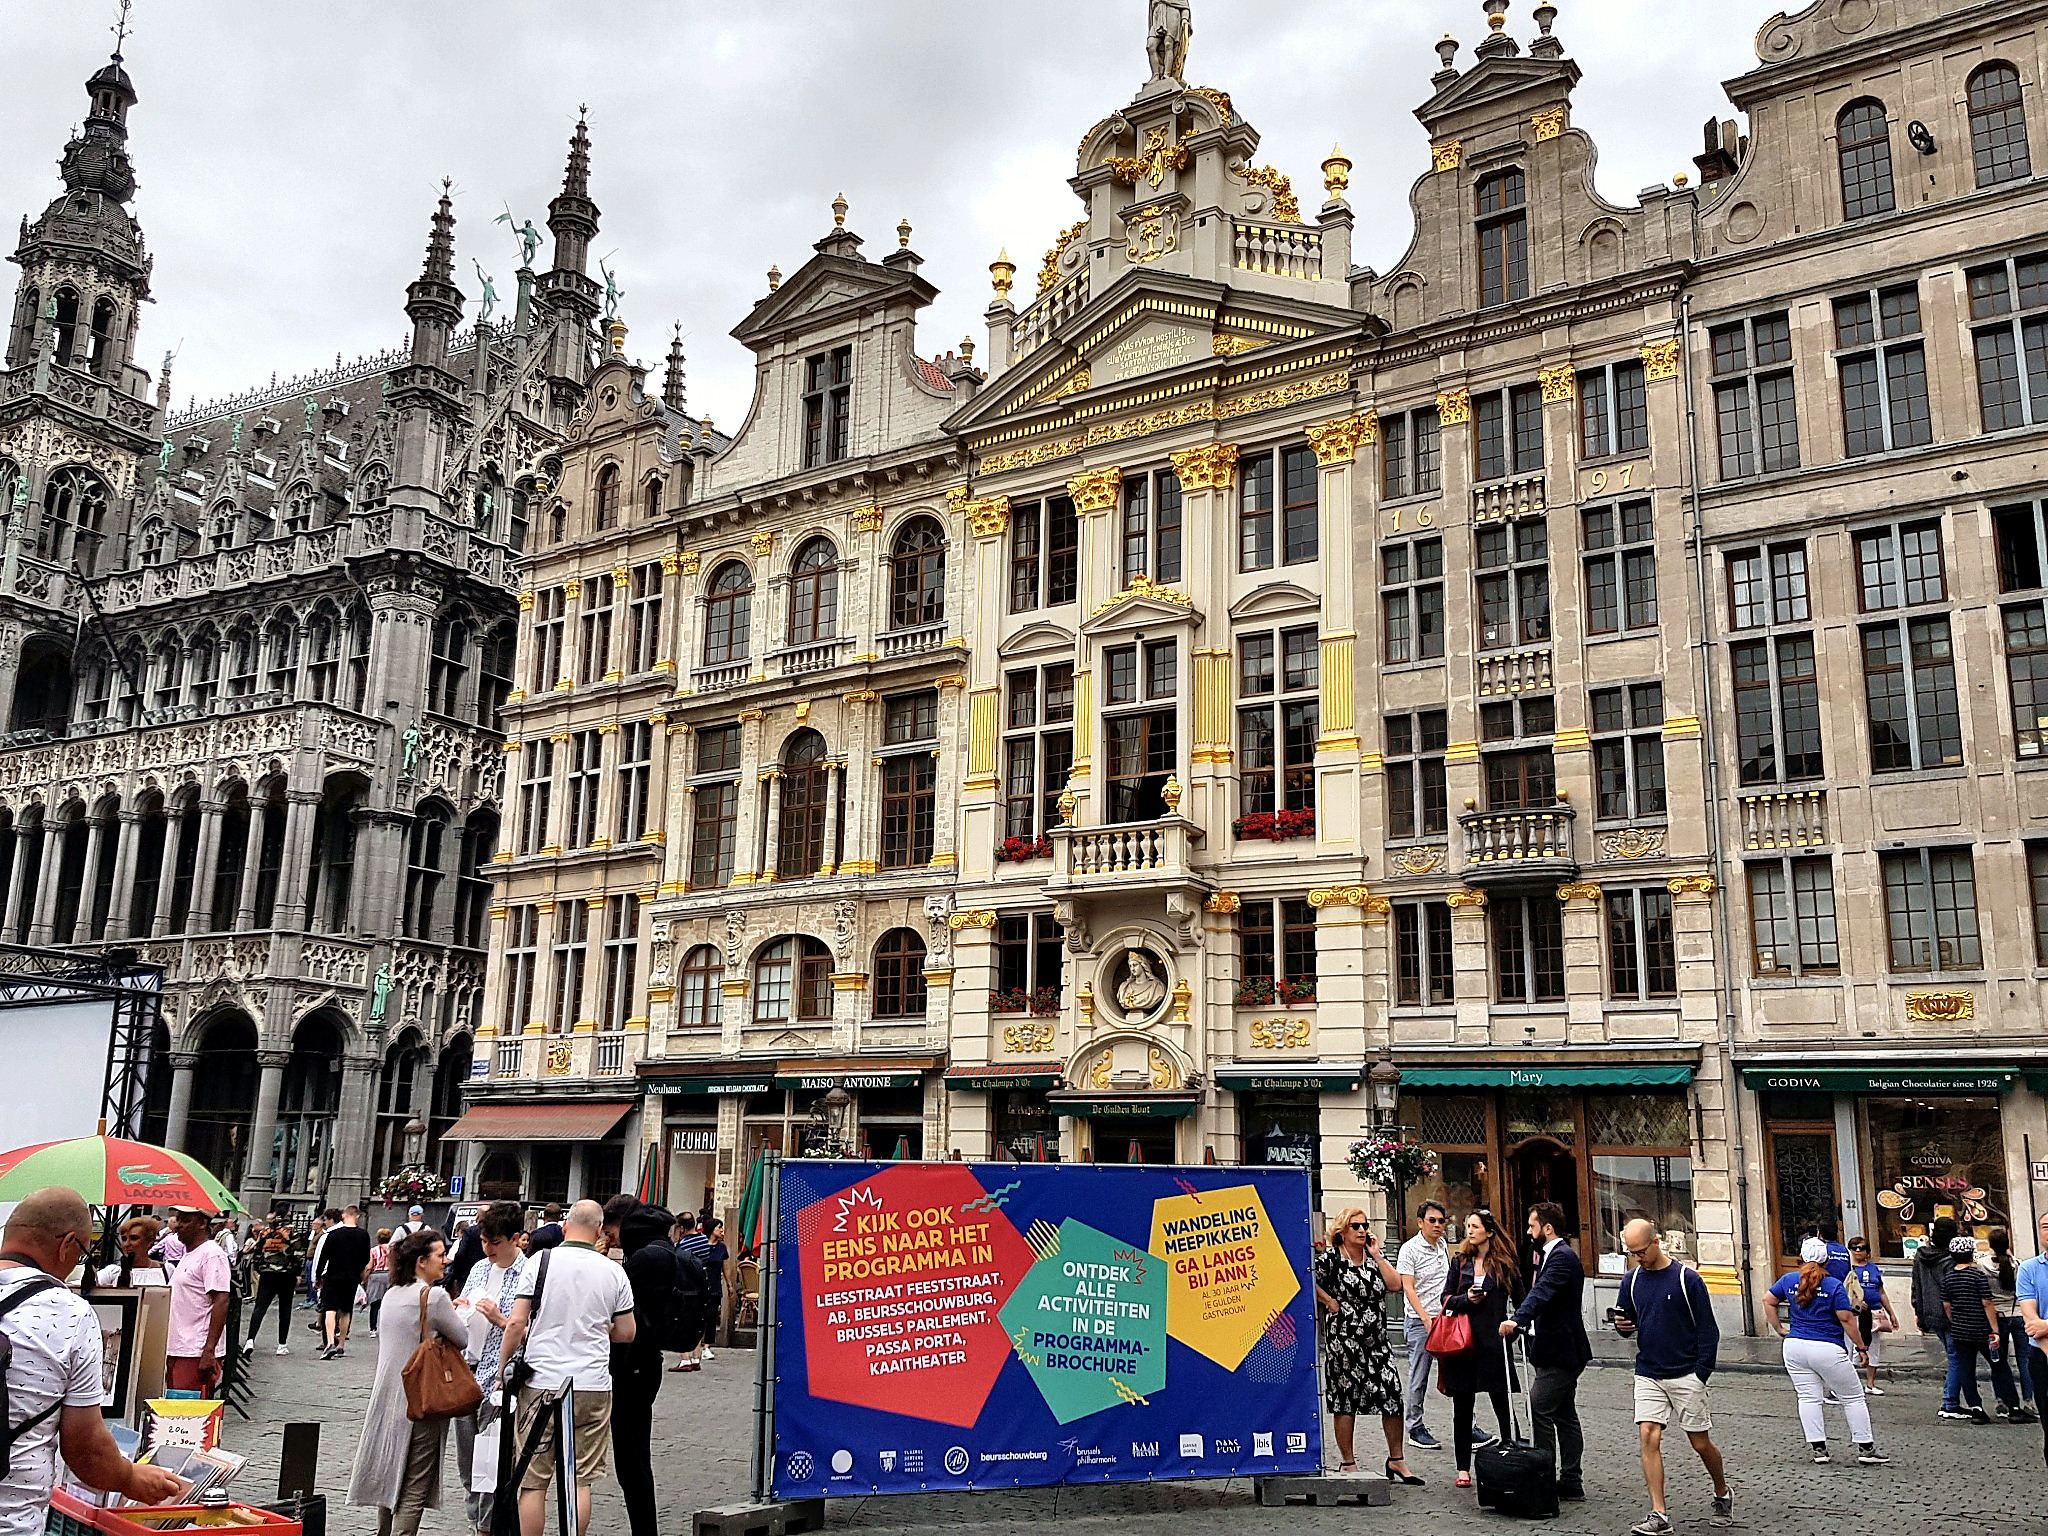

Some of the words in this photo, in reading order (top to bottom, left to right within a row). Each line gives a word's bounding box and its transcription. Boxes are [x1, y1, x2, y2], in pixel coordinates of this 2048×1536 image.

[1591, 464, 1634, 494] 97
[1922, 1001, 1956, 1013] ANNA
[801, 1078, 834, 1088] MAISO
[844, 1077, 890, 1087] ANTOINE
[971, 1080, 981, 1088] La
[982, 1079, 1014, 1088] Chaloupe
[1251, 1079, 1261, 1088] La
[1264, 1079, 1302, 1089] Chaloupe
[1510, 1070, 1543, 1085] Mary
[1768, 1078, 1820, 1087] GODIVA
[1869, 1080, 1899, 1089] Belgian
[1902, 1079, 1951, 1088] Chocolatier
[1953, 1080, 1974, 1088] since
[1977, 1080, 1998, 1088] 1926
[648, 1084, 681, 1094] Neuhaus
[1092, 1105, 1102, 1114] De
[1104, 1105, 1130, 1114] Gulden
[674, 1132, 716, 1149] NEUHAU
[1911, 1156, 1952, 1164] GODIVA
[1903, 1176, 1969, 1189] SENSES
[124, 1189, 192, 1200] LACOSTE
[1845, 1200, 1856, 1209] 22
[857, 1212, 900, 1234] KIJK
[907, 1206, 954, 1228] OOK
[1163, 1207, 1256, 1236] WANDELING
[823, 1237, 877, 1260] EENS
[883, 1230, 944, 1253] NAAR
[950, 1224, 990, 1245] HET
[1165, 1222, 1258, 1255] MEEPIKKEN?
[824, 1250, 966, 1282] PROGRAMMA
[972, 1245, 992, 1264] IN
[1175, 1258, 1199, 1274] GA
[1203, 1246, 1256, 1269] LANGS
[1063, 1262, 1130, 1282] ONTDEK
[1188, 1273, 1208, 1289] BIJ
[1214, 1264, 1248, 1284] ANN
[816, 1285, 903, 1307] LEESSTRAAT
[907, 1273, 1004, 1296] FEESTSTRAAT,
[1075, 1281, 1116, 1298] ALLE
[1223, 1285, 1240, 1295] JAAR
[827, 1312, 850, 1325] AB,
[854, 1292, 997, 1321] BEURSSCHOUWBURG,
[1038, 1296, 1150, 1319] ACTIVITEITEN
[1205, 1301, 1211, 1309] JE
[1212, 1296, 1241, 1308] GULDEN
[1203, 1305, 1246, 1320] GASTVROUW
[836, 1322, 903, 1343] BRUSSELS
[907, 1311, 991, 1332] PARLEMENT,
[1072, 1317, 1088, 1333] IN
[1094, 1320, 1115, 1335] DE
[866, 1342, 912, 1357] PASSA
[914, 1333, 966, 1350] PORTA,
[1033, 1332, 1150, 1356] PROGRAMMA-
[870, 1351, 966, 1375] KAAITHEATER
[1046, 1353, 1136, 1374] BROCHURE
[1076, 1446, 1100, 1455] brussels
[1257, 1439, 1270, 1448] ibis
[949, 1453, 963, 1466] AB
[980, 1450, 1047, 1461] beursschouwburg
[1077, 1455, 1117, 1466] philharmonic
